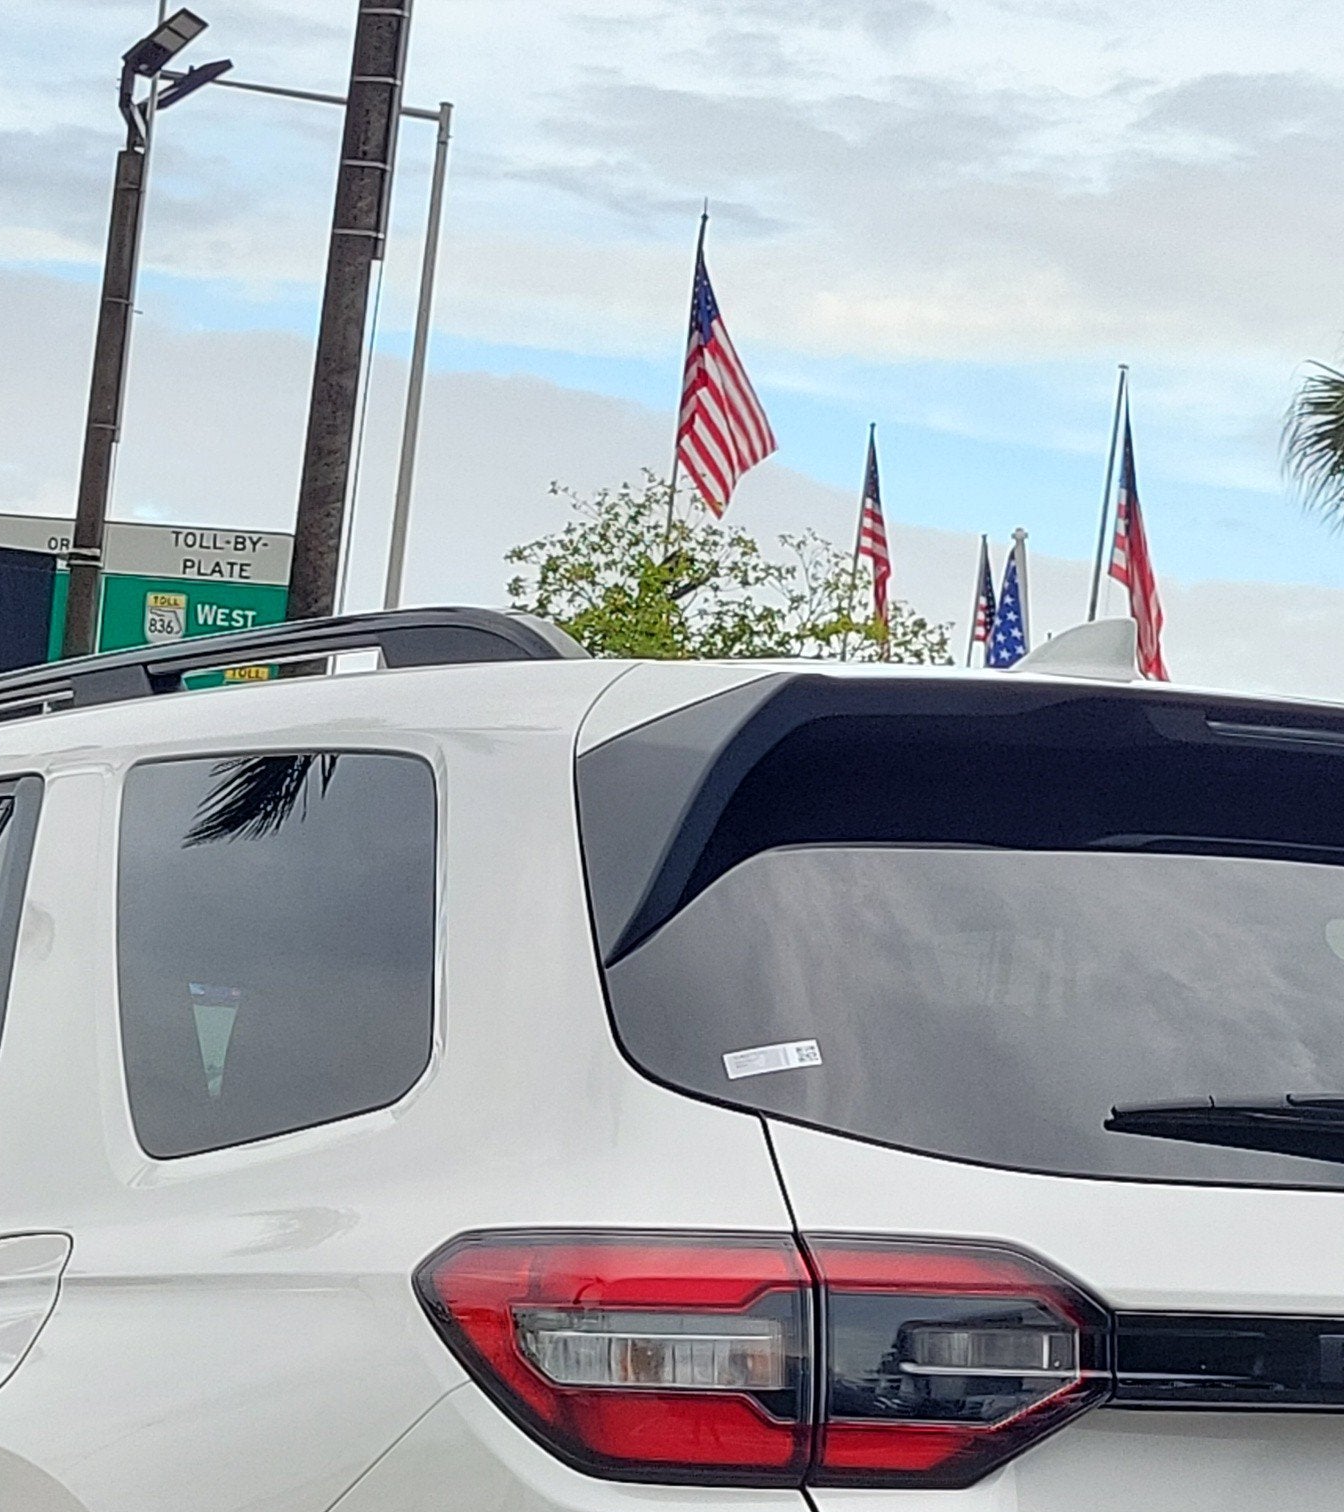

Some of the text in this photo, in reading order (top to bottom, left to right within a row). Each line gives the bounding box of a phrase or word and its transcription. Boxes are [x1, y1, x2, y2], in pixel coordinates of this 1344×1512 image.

[47, 537, 70, 549] OR
[172, 531, 269, 551] TOLL-BY-
[182, 559, 252, 579] PLATE
[153, 595, 181, 607] TOLL
[197, 604, 257, 627] WEST
[148, 617, 175, 635] 836
